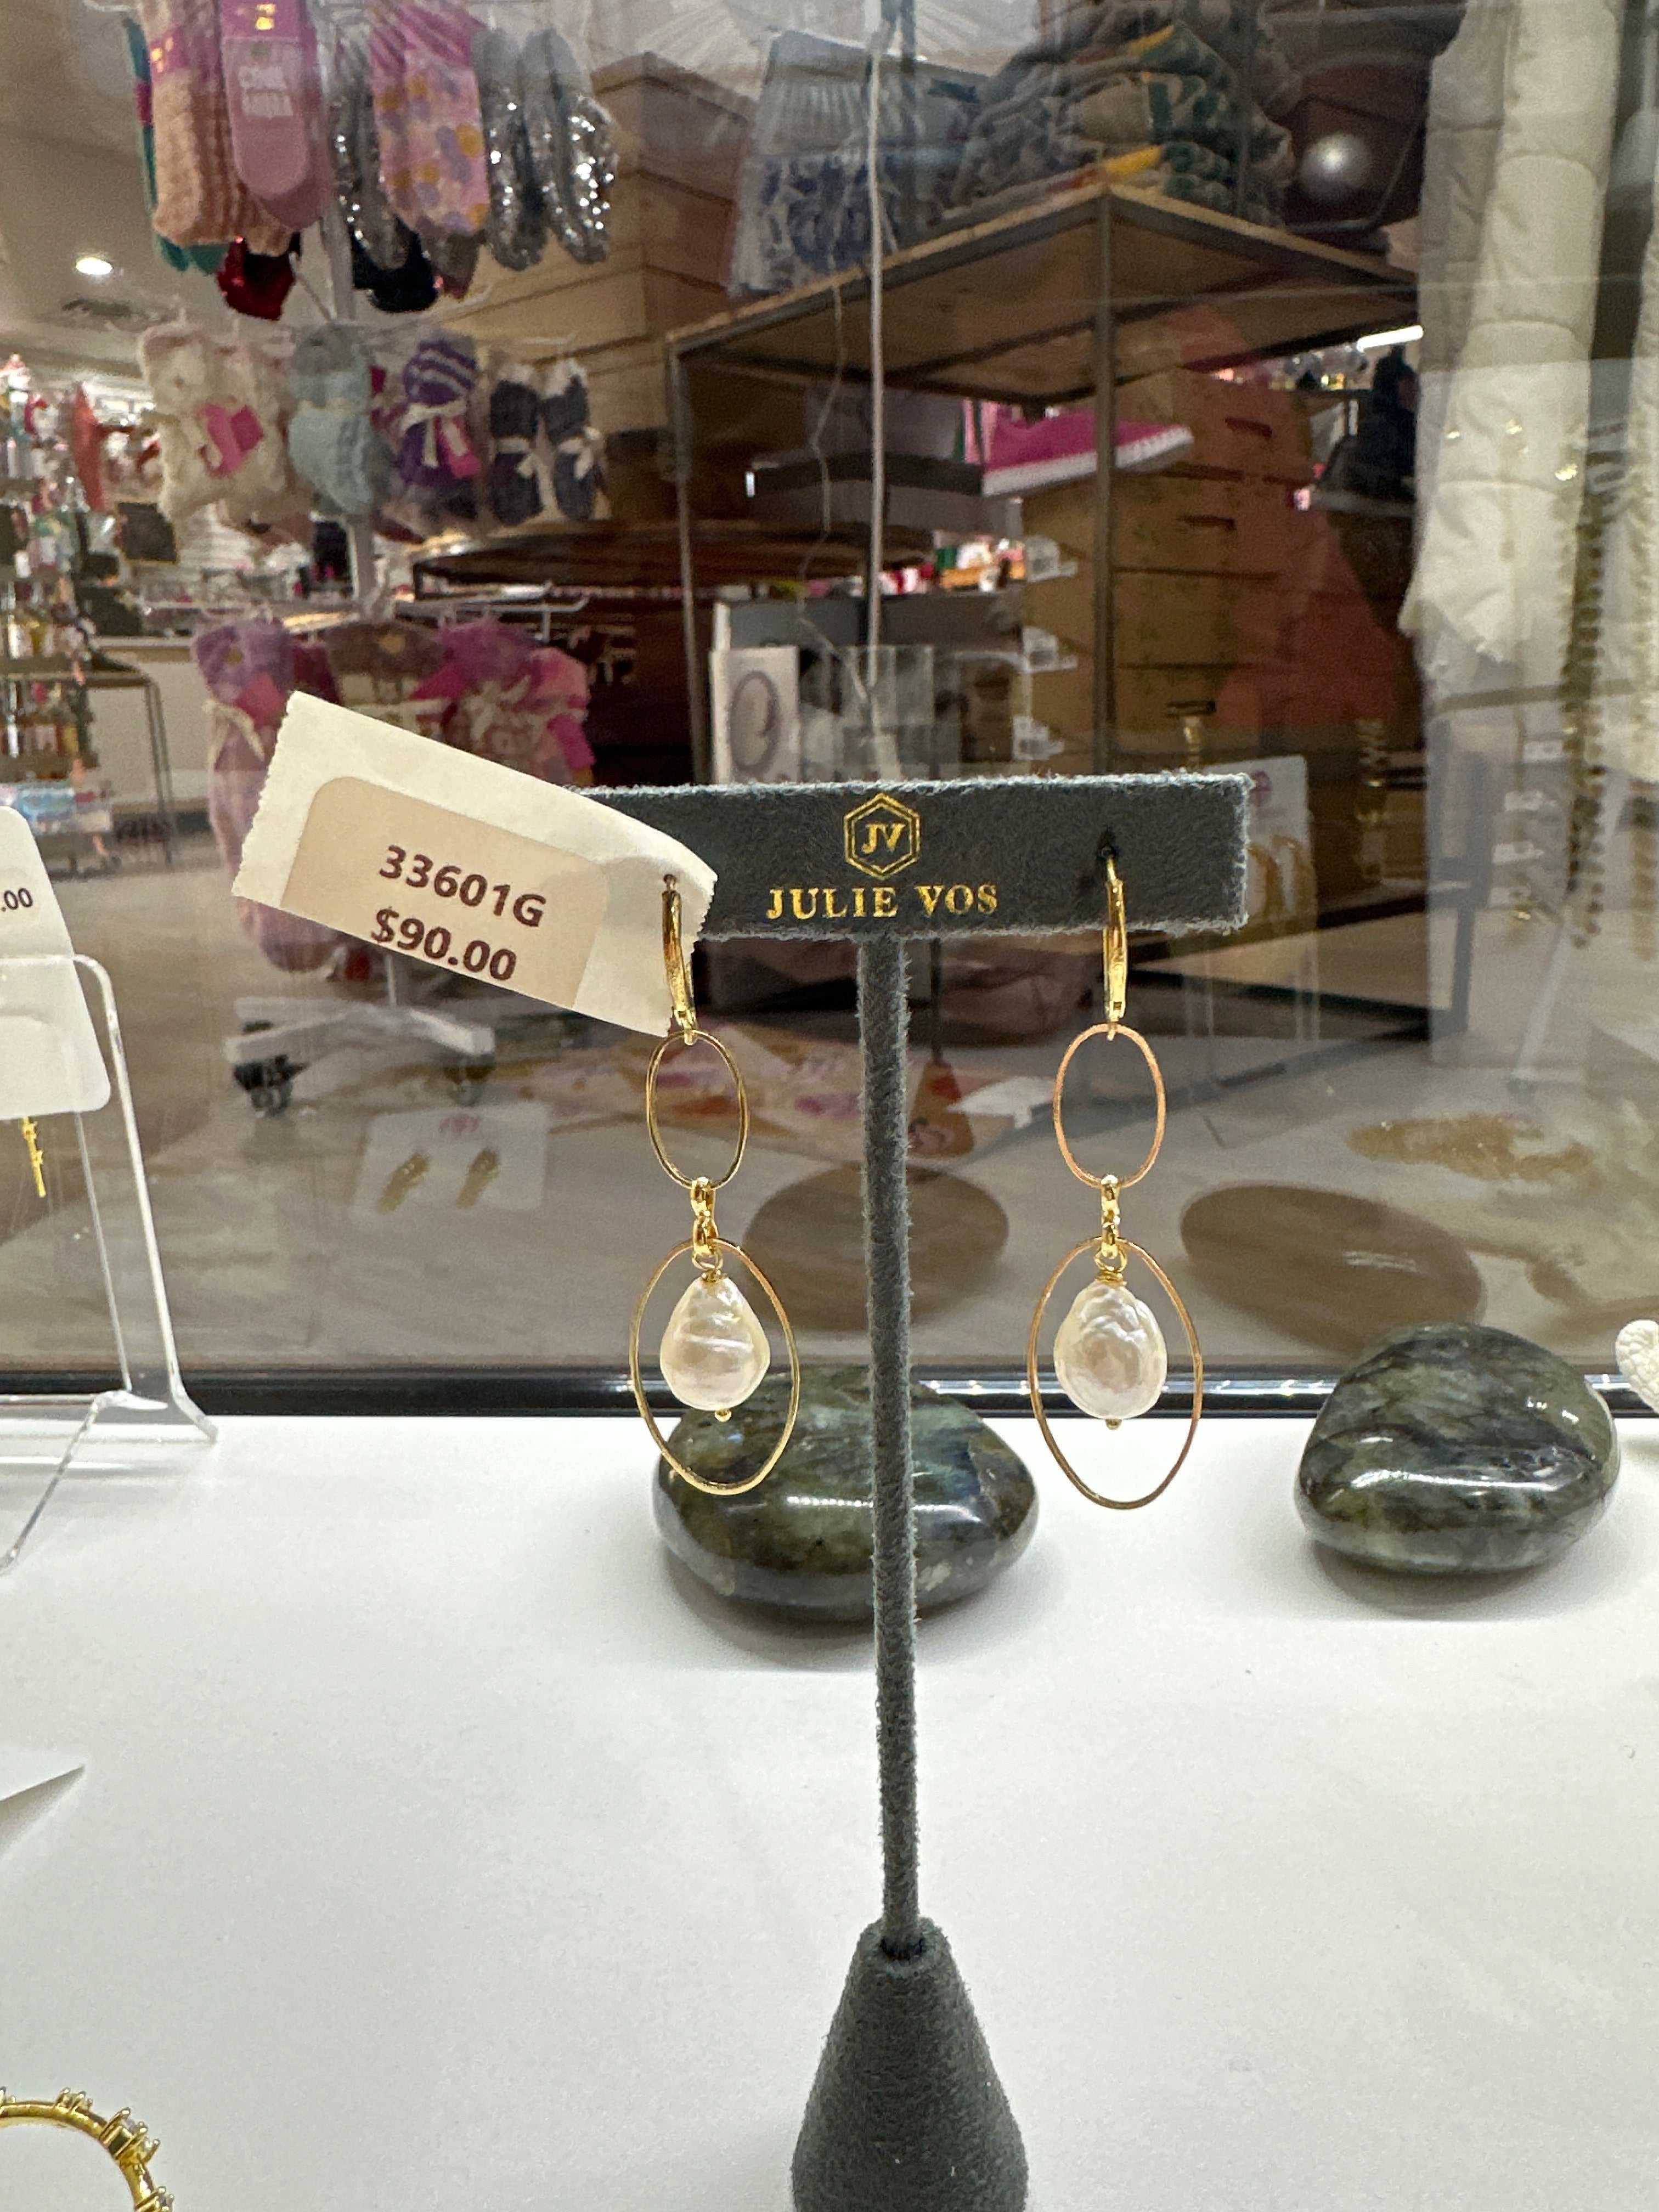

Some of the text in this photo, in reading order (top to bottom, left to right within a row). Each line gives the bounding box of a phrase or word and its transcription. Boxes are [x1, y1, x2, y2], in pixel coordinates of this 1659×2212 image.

[861, 822, 906, 855] JV
[379, 844, 546, 928] 33601G
[766, 883, 998, 920] JULIE VOS
[370, 906, 517, 981] $90.00
